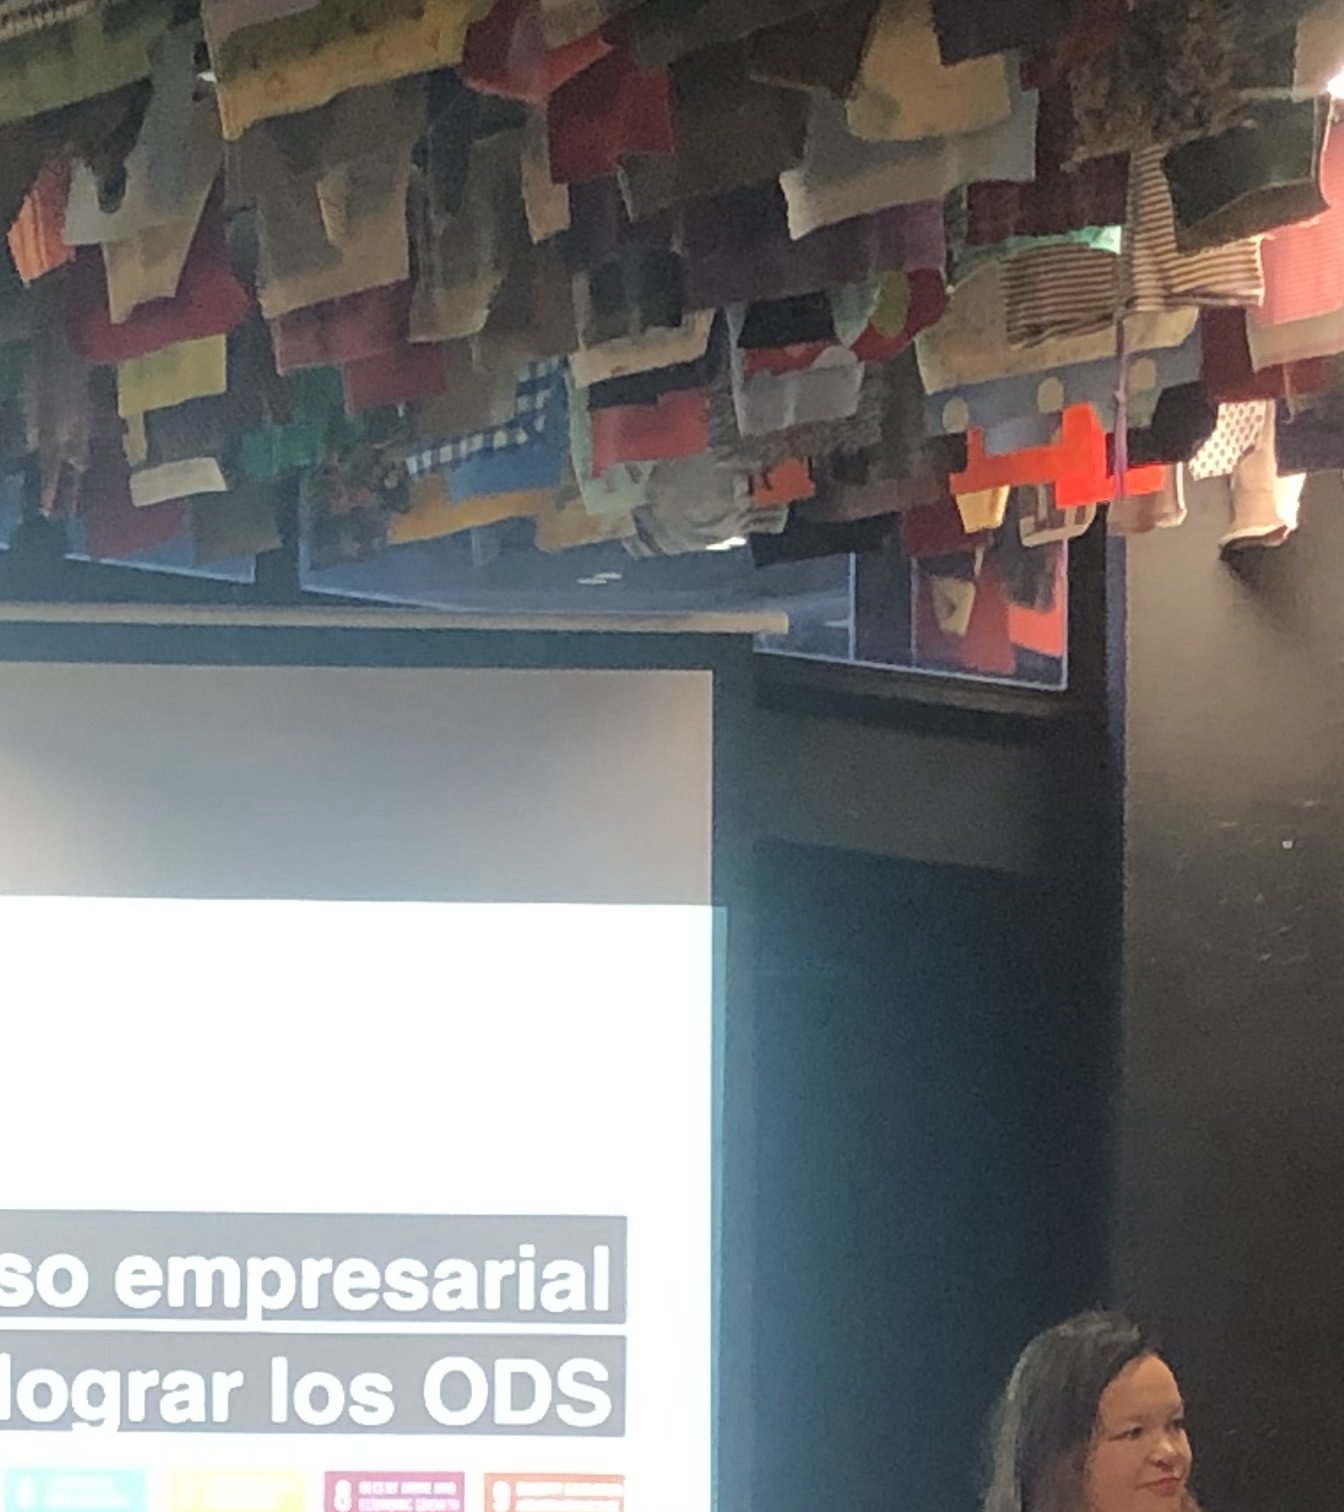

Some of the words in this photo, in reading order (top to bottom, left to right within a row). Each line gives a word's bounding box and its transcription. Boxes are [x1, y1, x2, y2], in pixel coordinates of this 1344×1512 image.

[114, 1244, 611, 1323] empresarial
[270, 1356, 395, 1425] los
[422, 1356, 612, 1429] ODS
[334, 1479, 352, 1512] 8
